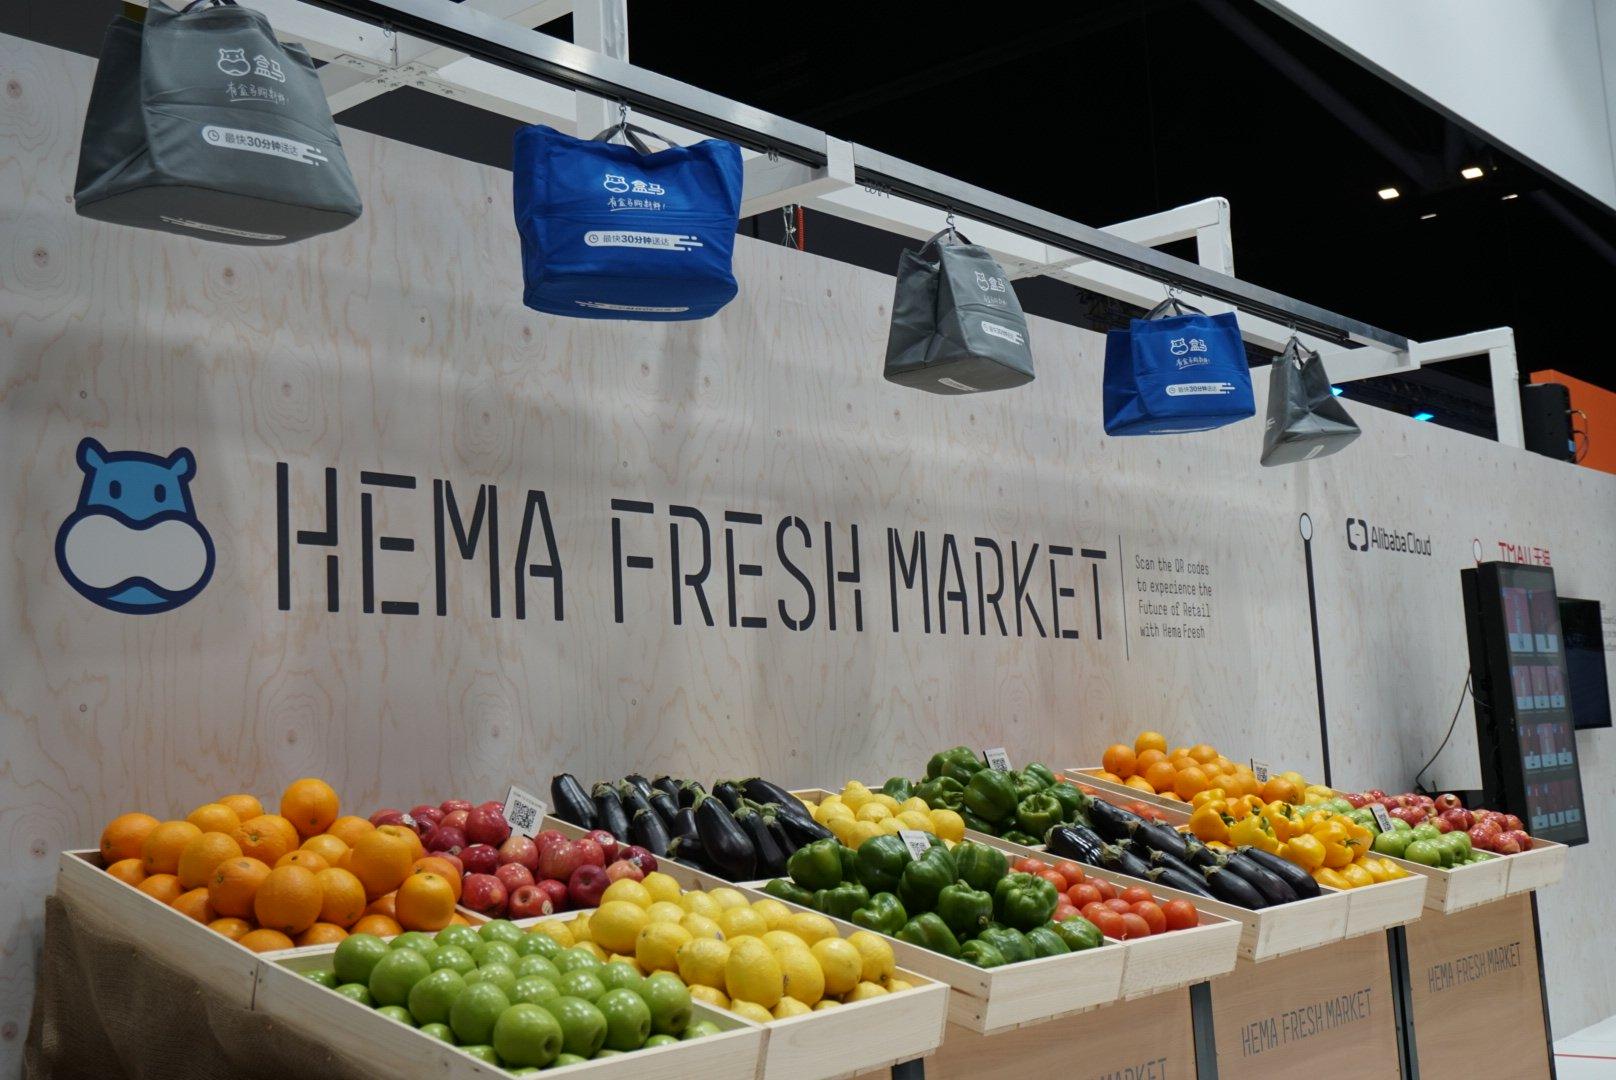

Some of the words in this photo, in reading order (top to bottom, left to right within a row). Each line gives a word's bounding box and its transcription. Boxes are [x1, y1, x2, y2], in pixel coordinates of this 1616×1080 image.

[253, 54, 286, 82] 盒马
[630, 180, 665, 195] 盒马
[603, 234, 670, 246] 最快30分钟送达
[1189, 338, 1208, 352] 盒马
[276, 462, 564, 621] HEMA
[611, 498, 863, 631] FRESH
[887, 527, 1107, 640] MARKET
[1371, 526, 1407, 553] Alibaba
[1407, 532, 1431, 557] Cloud
[1135, 554, 1155, 570] Scan
[1158, 557, 1172, 572] the
[1175, 558, 1185, 573] QR
[1187, 562, 1210, 576] codes
[1137, 577, 1147, 592] to
[1150, 580, 1196, 597] experience
[1198, 582, 1212, 597] the
[1138, 599, 1168, 616] Future
[1171, 601, 1180, 616] of
[1183, 602, 1211, 618] Retail
[1140, 622, 1160, 637] with
[1427, 962, 1454, 994] HEMA
[1456, 952, 1487, 985] FRESH
[1487, 942, 1521, 975] MARKET
[1241, 1017, 1279, 1057] HEMA
[1282, 1003, 1324, 1044] FRESH
[1325, 988, 1371, 1030] MARKET
